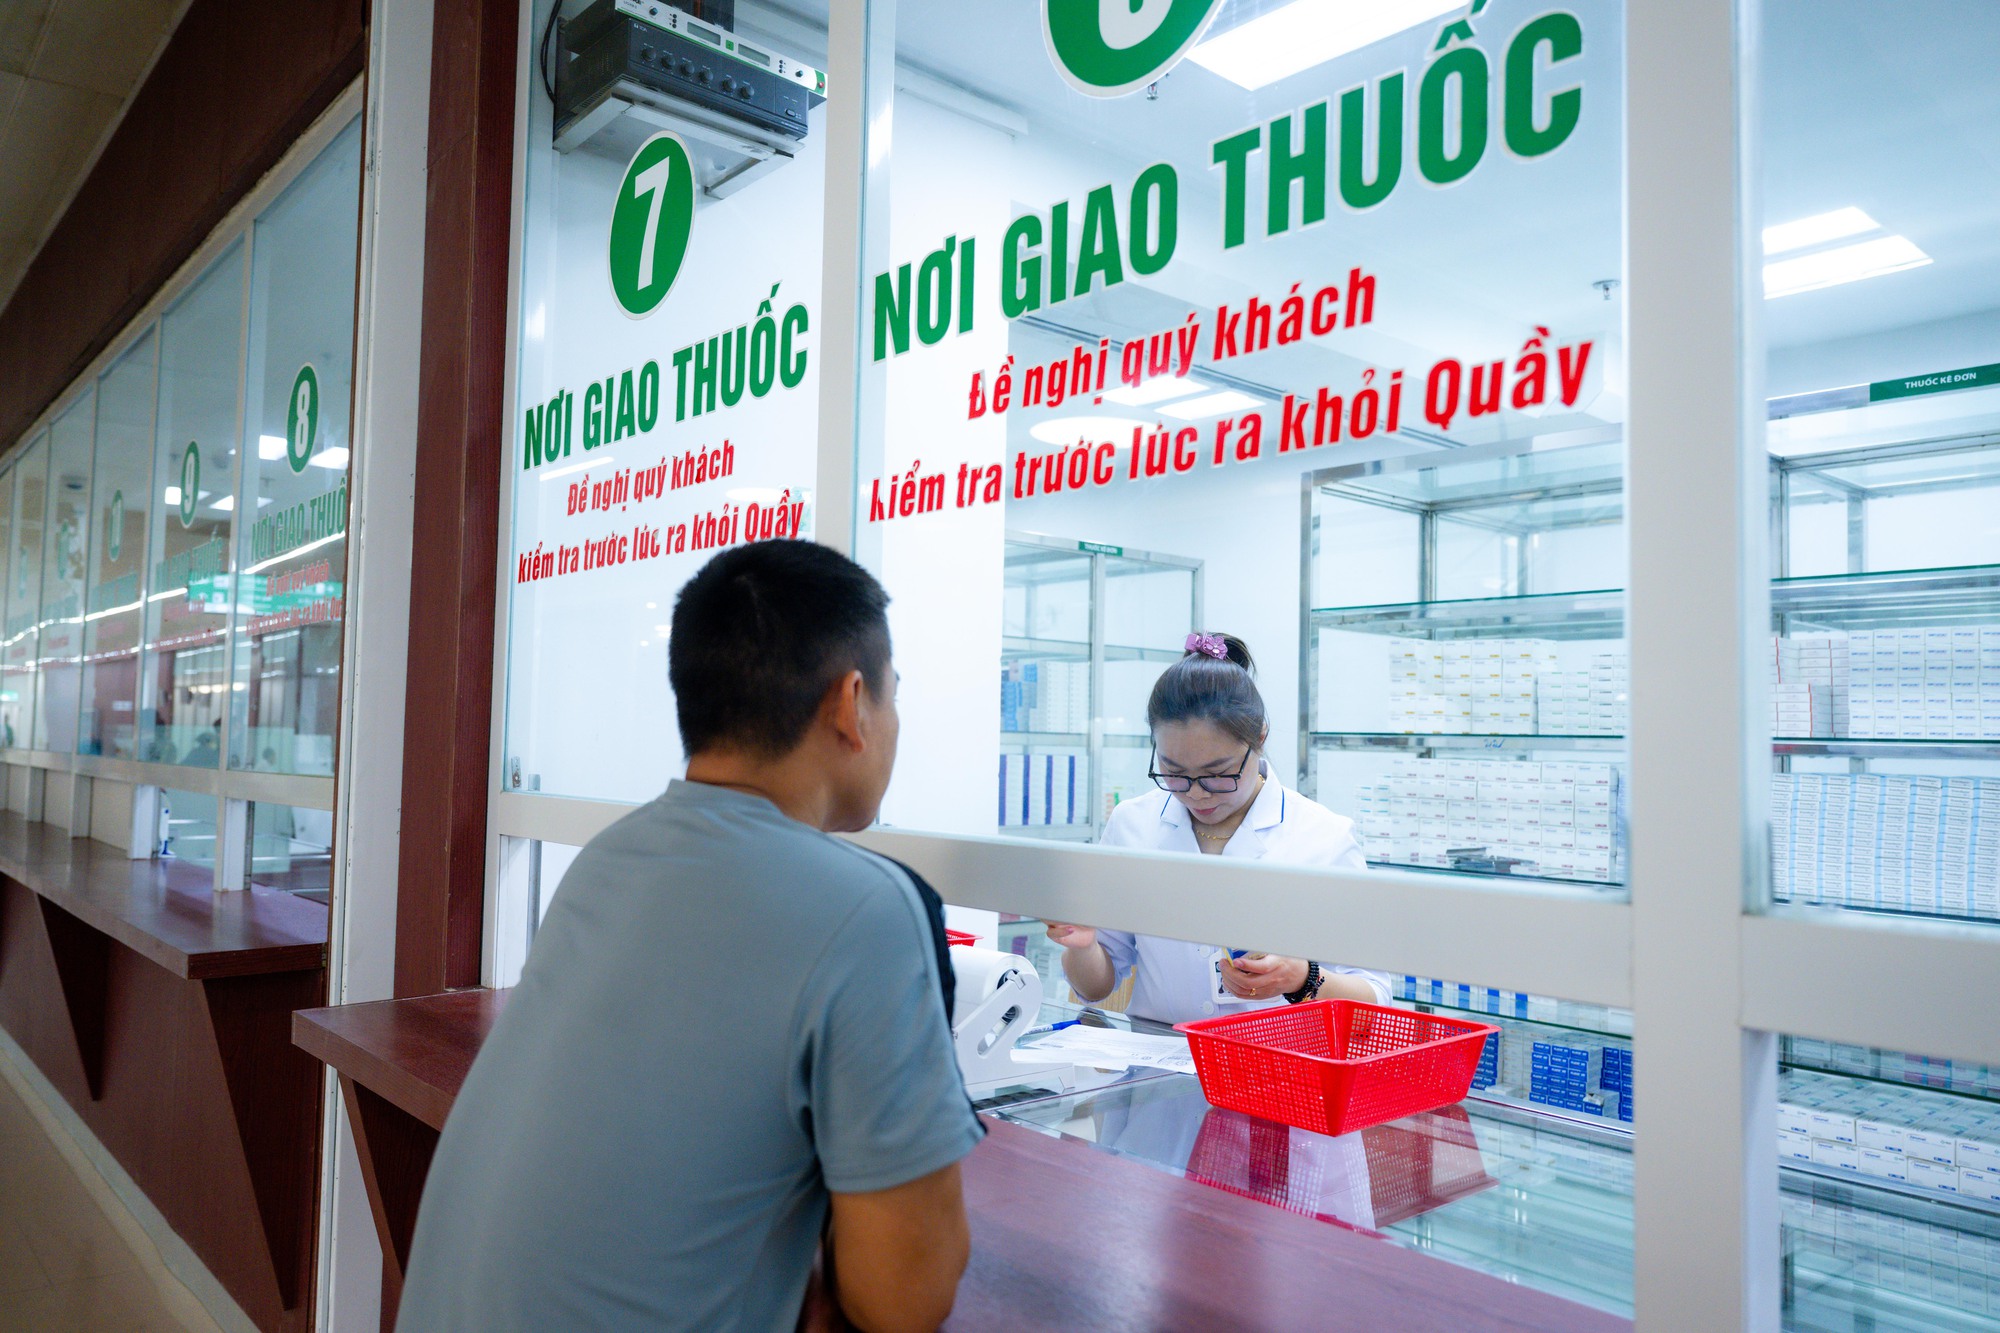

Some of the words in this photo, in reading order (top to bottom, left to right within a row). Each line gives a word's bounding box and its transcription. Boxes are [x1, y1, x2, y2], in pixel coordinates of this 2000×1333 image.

[633, 155, 671, 291] 7
[872, 235, 975, 361] NƠI
[1001, 163, 1178, 319] GIAO
[1213, 0, 1581, 249] THUỐC
[523, 389, 573, 470] NƠI
[583, 360, 659, 450] GIAO
[673, 282, 809, 422] THUỐC
[967, 355, 1015, 420] Đề
[1022, 338, 1109, 409] nghị
[1121, 312, 1201, 387] quý
[1212, 267, 1377, 362] khách
[1904, 376, 1939, 389] THUỐC
[1953, 372, 1977, 383] ĐƠN
[295, 380, 311, 458] 8
[869, 459, 946, 523] kiểm
[955, 463, 1003, 509] tra
[1013, 439, 1116, 499] trước
[1128, 424, 1199, 480] lúc
[1213, 412, 1263, 466] ra
[1278, 368, 1404, 454] khỏi
[183, 451, 196, 515] 9
[251, 512, 273, 562] NƠI
[274, 502, 305, 554] GIAO
[309, 470, 347, 542] THUỐ
[567, 474, 589, 516] Đề
[591, 468, 631, 512] nghị
[633, 457, 667, 503] quý
[670, 439, 735, 491] khách
[517, 541, 555, 584] kiểm
[557, 545, 580, 576] tra
[583, 532, 628, 571] trước
[631, 524, 661, 561] lúc
[665, 523, 687, 555] ra
[691, 503, 739, 551] khỏi
[744, 489, 804, 543] Quầy
